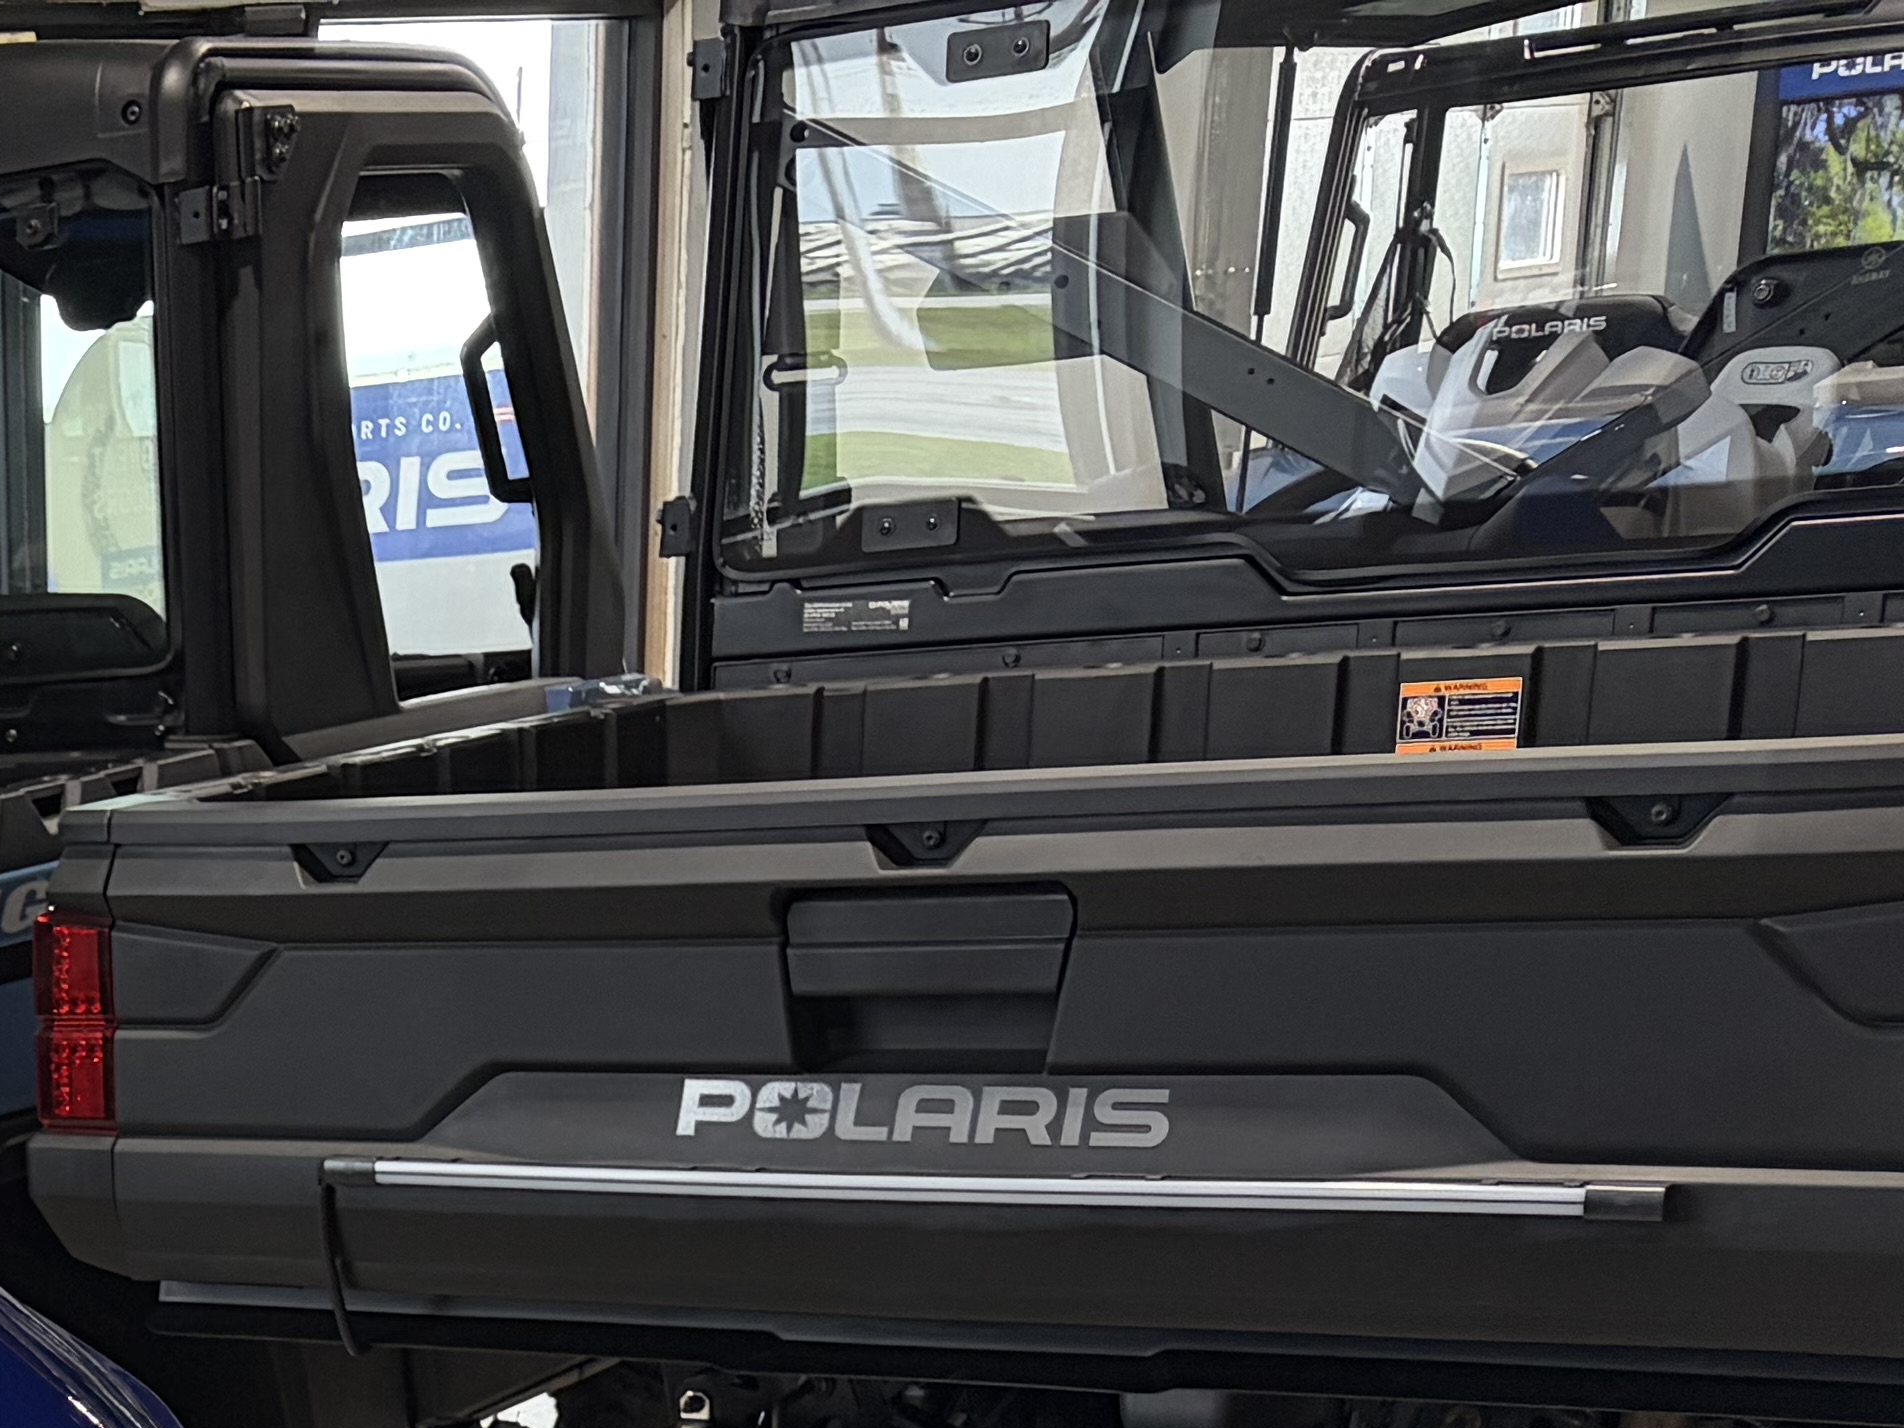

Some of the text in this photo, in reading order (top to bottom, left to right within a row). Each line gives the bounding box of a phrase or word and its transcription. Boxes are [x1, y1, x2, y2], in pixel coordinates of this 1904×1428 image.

[1491, 315, 1608, 341] POLARIS
[352, 410, 462, 441] RTS CO.
[675, 1077, 1171, 1149] POLARIS
